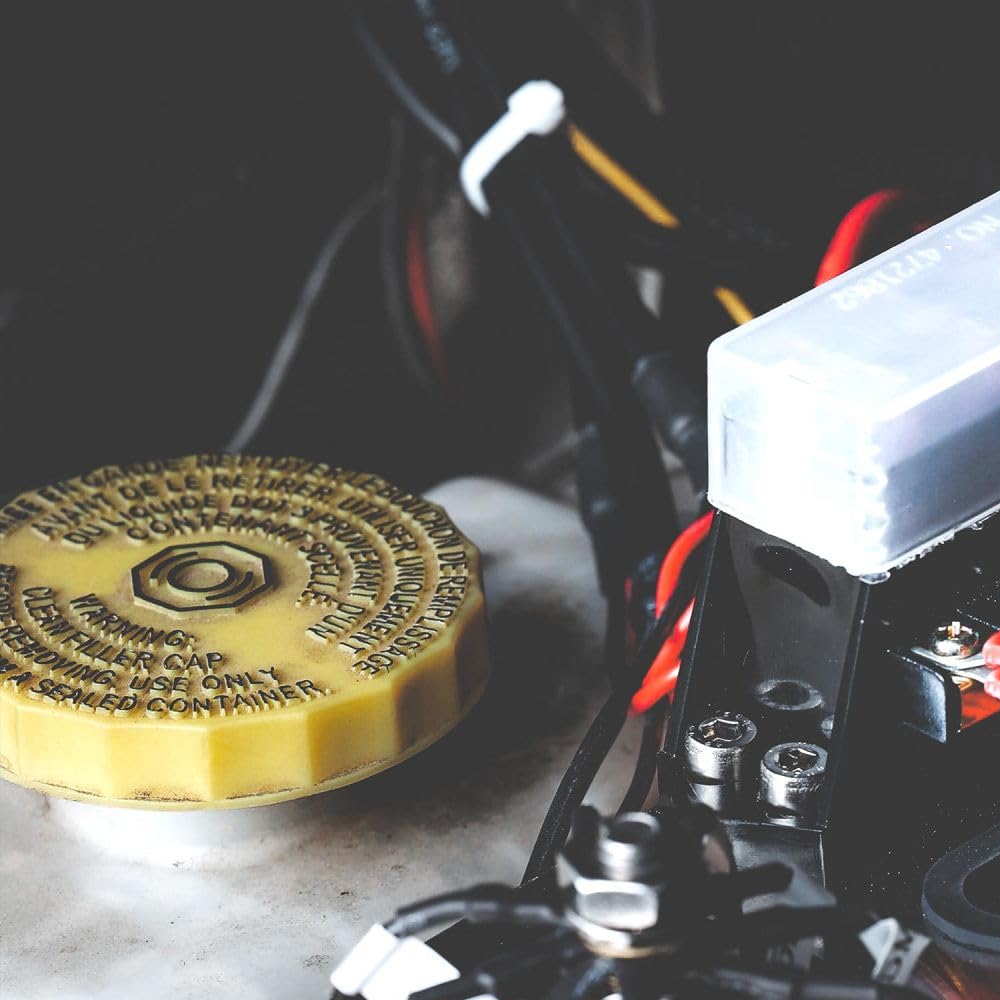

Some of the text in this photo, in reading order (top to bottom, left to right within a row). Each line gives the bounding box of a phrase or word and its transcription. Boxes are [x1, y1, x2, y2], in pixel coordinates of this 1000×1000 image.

[117, 480, 159, 500] DE
[166, 474, 202, 492] LE
[31, 493, 114, 537] AVANT
[126, 511, 313, 543] CONTENANT
[337, 497, 418, 553] UTILISER
[63, 523, 104, 545] DU
[100, 494, 218, 527] LIQUIDE
[309, 511, 384, 601] PROVENANT
[437, 550, 467, 573] DE
[338, 556, 425, 655] UNIQUEMENT
[22, 586, 75, 637] CLEAN
[60, 630, 154, 671] FILLER
[163, 652, 223, 672] CAP
[351, 575, 467, 676] REMPLISSAGE
[30, 678, 138, 712] SEALED
[129, 675, 188, 693] USE
[201, 666, 280, 691] ONLY
